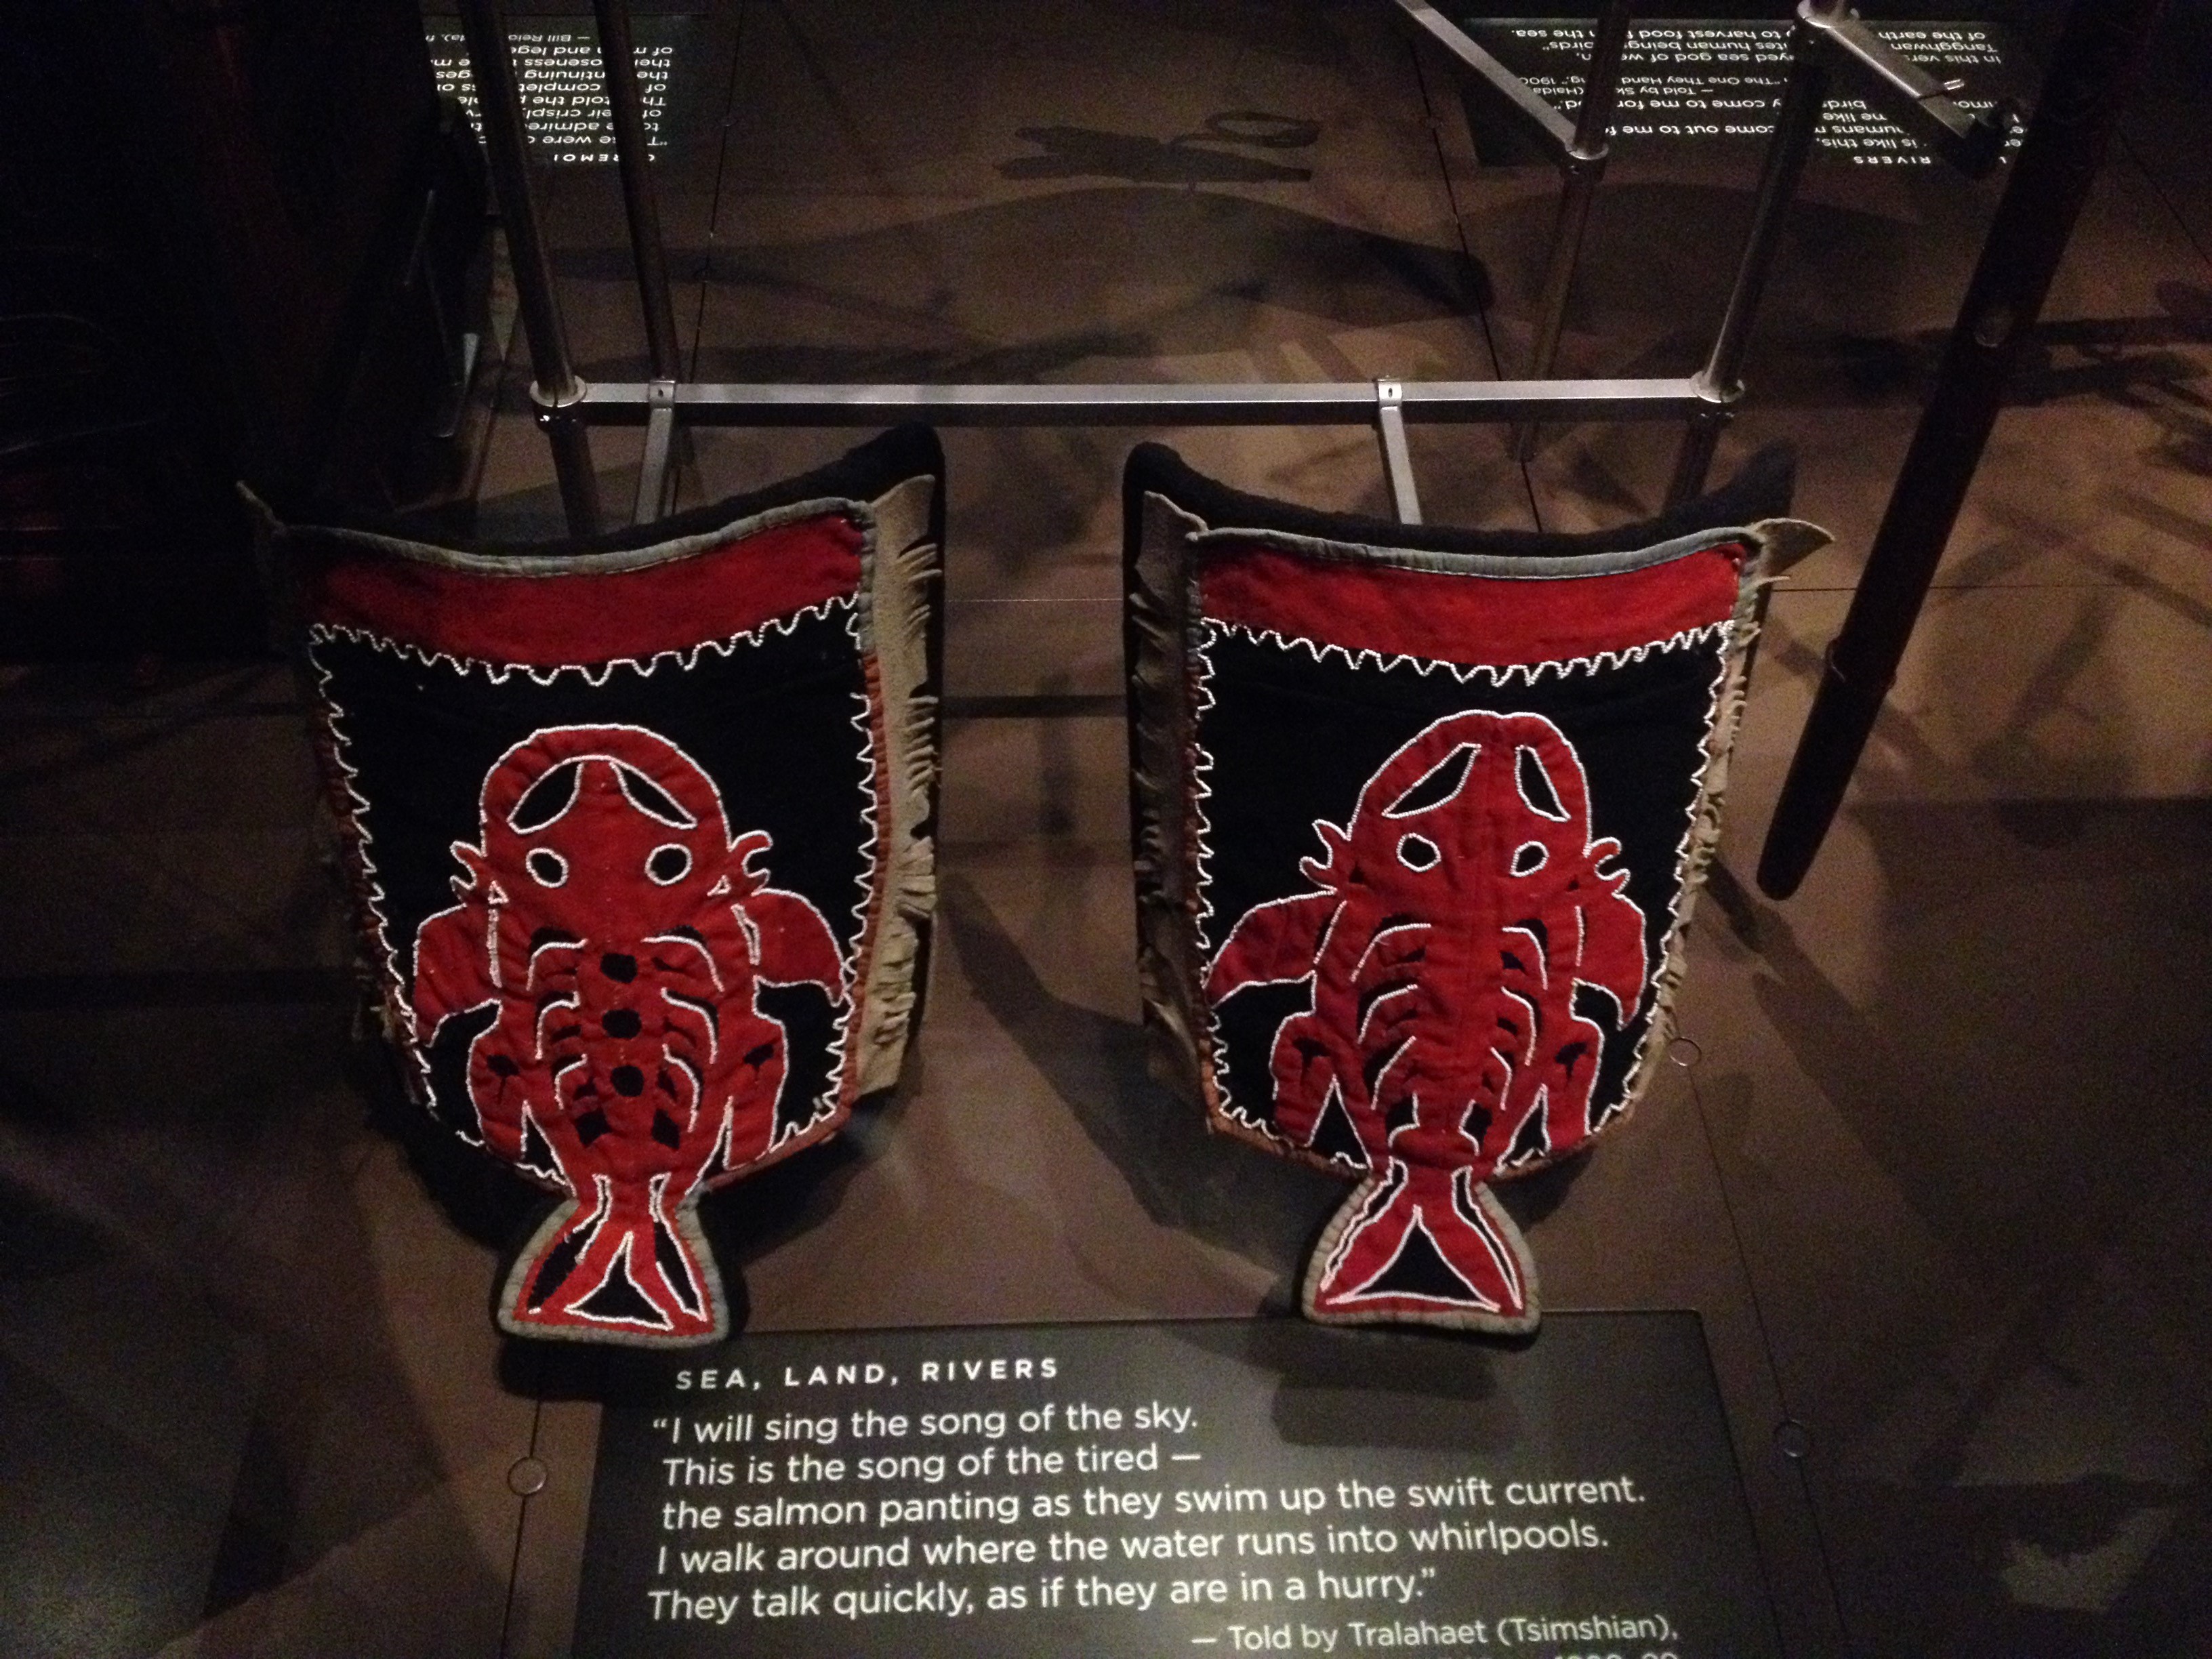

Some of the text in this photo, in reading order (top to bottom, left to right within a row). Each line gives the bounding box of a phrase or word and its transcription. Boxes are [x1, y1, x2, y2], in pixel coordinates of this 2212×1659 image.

[547, 34, 572, 43] Bill
[1511, 29, 1548, 38] sea.
[1553, 29, 1584, 39] the
[1638, 30, 1683, 40] food
[1687, 30, 1757, 40] harvest
[1761, 30, 1782, 39] to
[1878, 31, 1927, 41] earth
[1931, 31, 1963, 41] the
[1967, 32, 1986, 41] of
[553, 46, 591, 56] and
[1685, 41, 1751, 52] human
[651, 47, 673, 57] of
[1717, 53, 1750, 61] sea
[1650, 53, 1669, 63] of
[1674, 52, 1713, 63] god
[1944, 54, 1980, 64] this
[1982, 55, 2002, 64] In
[1621, 77, 1662, 85] Hand
[1666, 75, 1704, 85] They
[1708, 77, 1740, 85] One
[644, 83, 666, 94] of
[1639, 85, 1660, 95] by
[1662, 87, 1697, 96] Told
[532, 96, 565, 106] the
[571, 96, 610, 106] told
[1616, 100, 1645, 110] for
[1650, 100, 1680, 108] me
[1685, 100, 1707, 109] to
[1711, 100, 1765, 108] come
[1822, 112, 1856, 123] like
[525, 121, 600, 133] admire
[1622, 125, 1654, 134] me
[1658, 125, 1681, 135] to
[1685, 125, 1719, 135] out
[542, 136, 592, 144] were
[1816, 137, 1918, 149] is like this.
[1853, 155, 1931, 165] RIVERS
[676, 1357, 1057, 1391] SEA, LAND, RIVERS
[694, 1414, 753, 1443] will
[765, 1413, 838, 1444] sing
[851, 1410, 909, 1437] the
[921, 1412, 1006, 1439] song
[1019, 1403, 1055, 1432] of
[1066, 1403, 1122, 1431] the
[1135, 1401, 1197, 1433] sky.
[663, 1458, 735, 1486] This
[748, 1456, 774, 1483] is
[787, 1454, 846, 1482] the
[858, 1456, 945, 1483] song
[958, 1446, 995, 1476] of
[1006, 1446, 1064, 1475] the
[1076, 1441, 1158, 1472] tired
[663, 1477, 1644, 1530] the salmon panting as they swim up the swift current.
[658, 1519, 1607, 1574] I walk around where the water runs into whirlpools.
[648, 1568, 1435, 1624] They talk quickly, as if they are in a hurry.”
[1227, 1624, 1292, 1650] Told
[1300, 1623, 1338, 1652] by
[1347, 1620, 1488, 1647] Tralahaet
